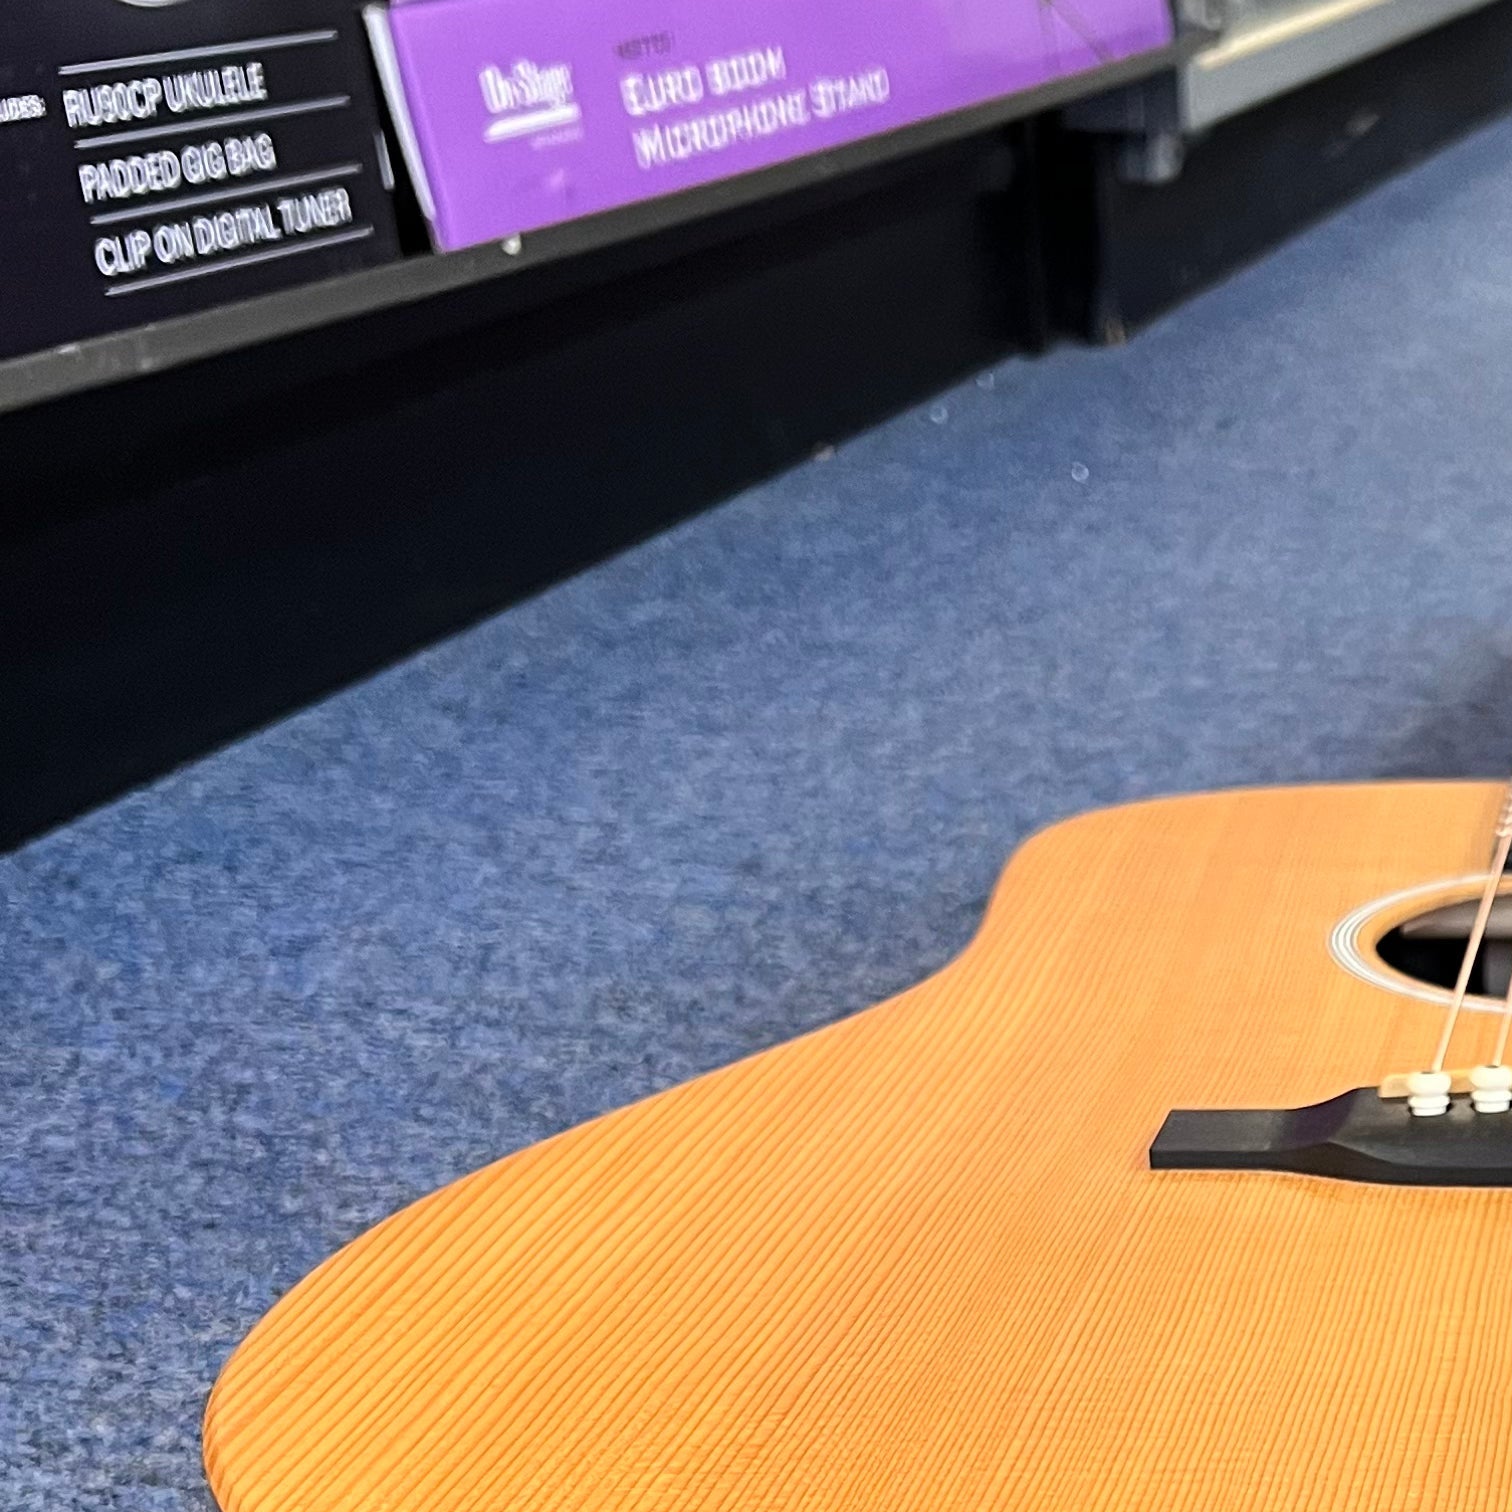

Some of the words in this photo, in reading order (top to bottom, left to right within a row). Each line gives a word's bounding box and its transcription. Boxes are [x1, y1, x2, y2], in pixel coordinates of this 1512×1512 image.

[162, 62, 268, 113] UKULELE
[633, 88, 811, 169] MICROPHONE
[808, 66, 890, 118] STAND
[78, 150, 182, 204] PADDED
[180, 140, 228, 185] GIG
[224, 132, 278, 176] BAG
[94, 229, 152, 276] CLIP
[153, 221, 196, 264] ON
[192, 203, 283, 255] DIGITAL
[276, 187, 354, 235] TUNER
